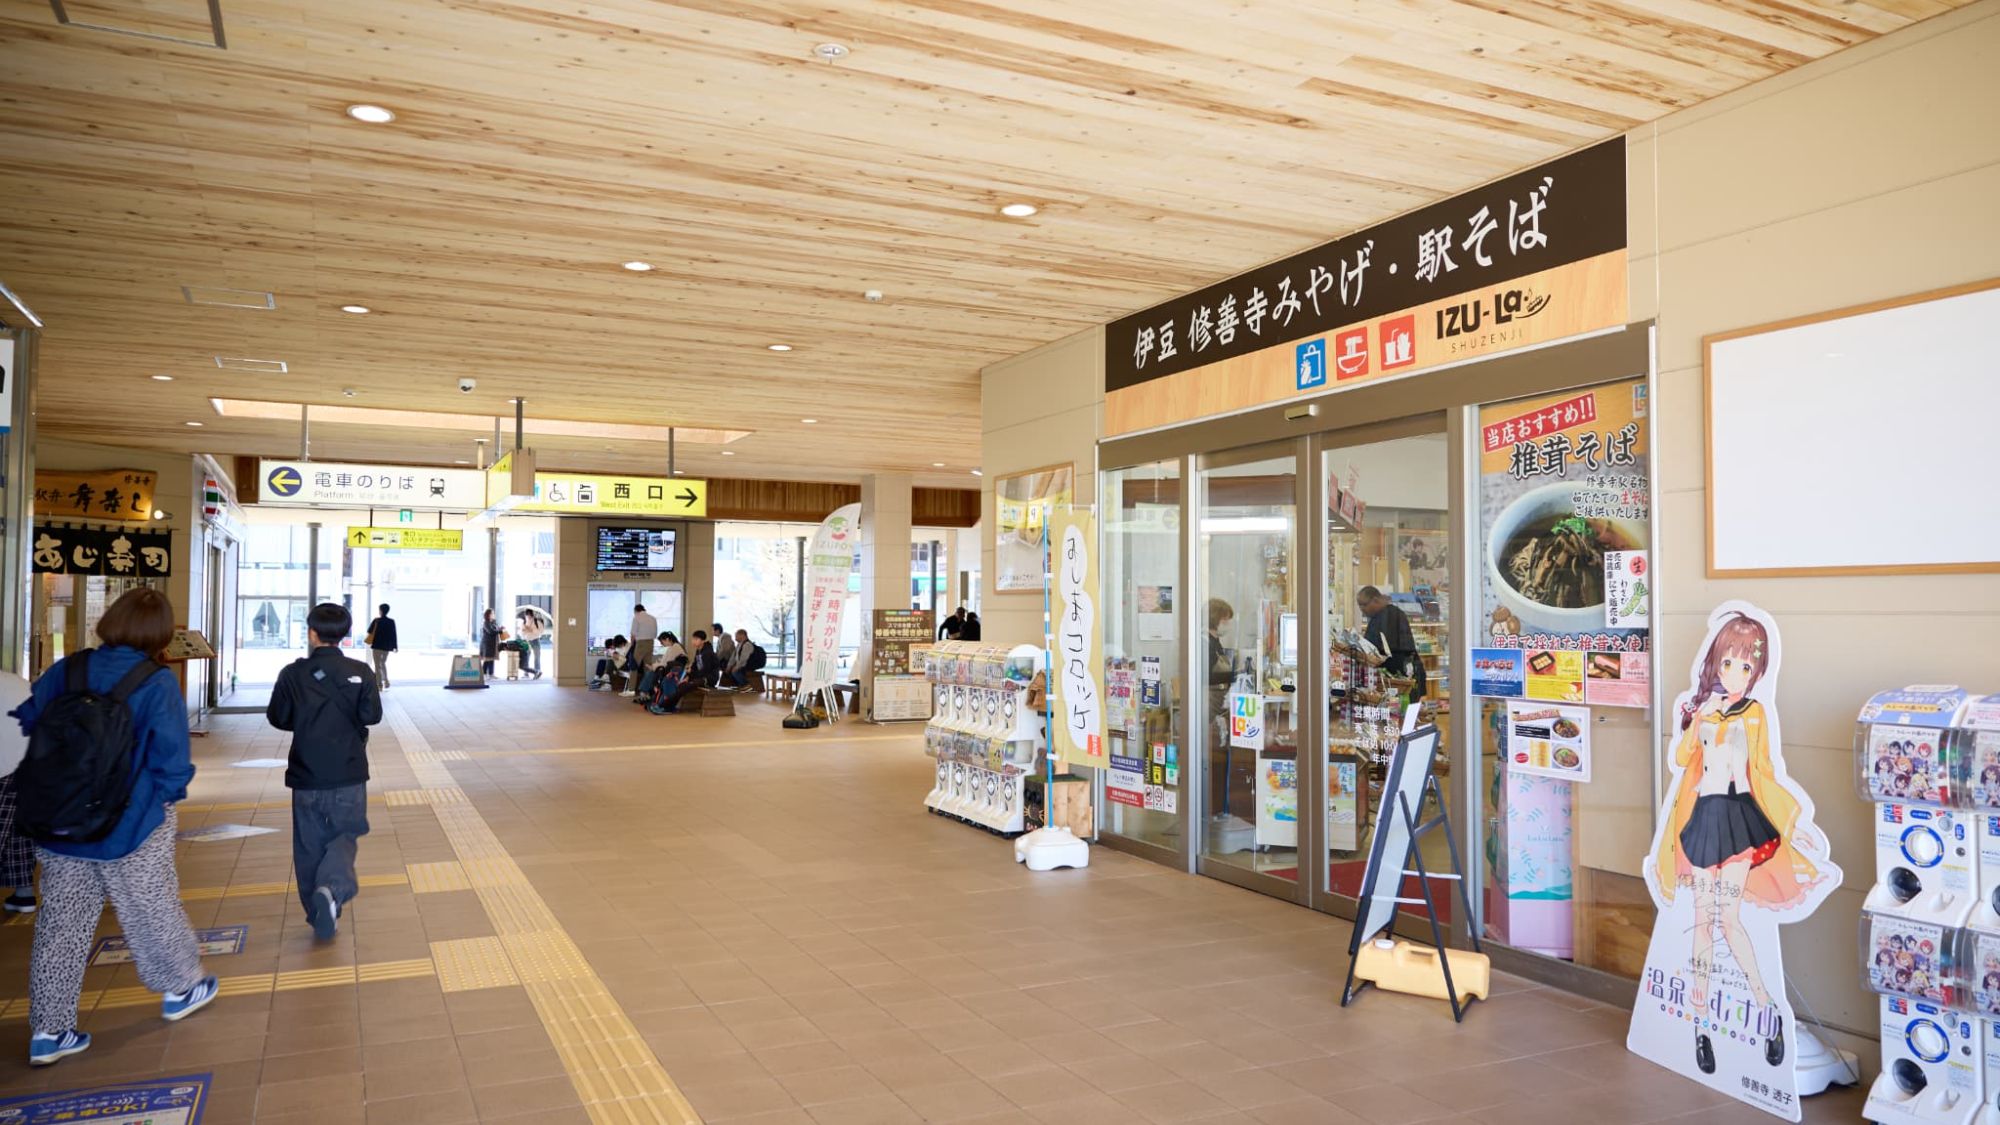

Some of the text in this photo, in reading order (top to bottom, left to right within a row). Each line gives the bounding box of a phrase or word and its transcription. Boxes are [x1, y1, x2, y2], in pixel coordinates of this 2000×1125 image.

[1133, 319, 1178, 370] 伊豆
[1451, 329, 1523, 353] SHUZENJI
[1487, 396, 1594, 448] 当店おすすめ!!
[1509, 423, 1639, 480] 椎茸そば
[315, 472, 415, 490] 電車のりば
[34, 533, 170, 573] あじ寿司
[805, 586, 825, 663] 配送サービス
[823, 589, 842, 650] 一時預かり
[1647, 967, 1684, 1006] 温泉
[1741, 1075, 1769, 1096] 修善寺
[1773, 1087, 1793, 1105] 透子
